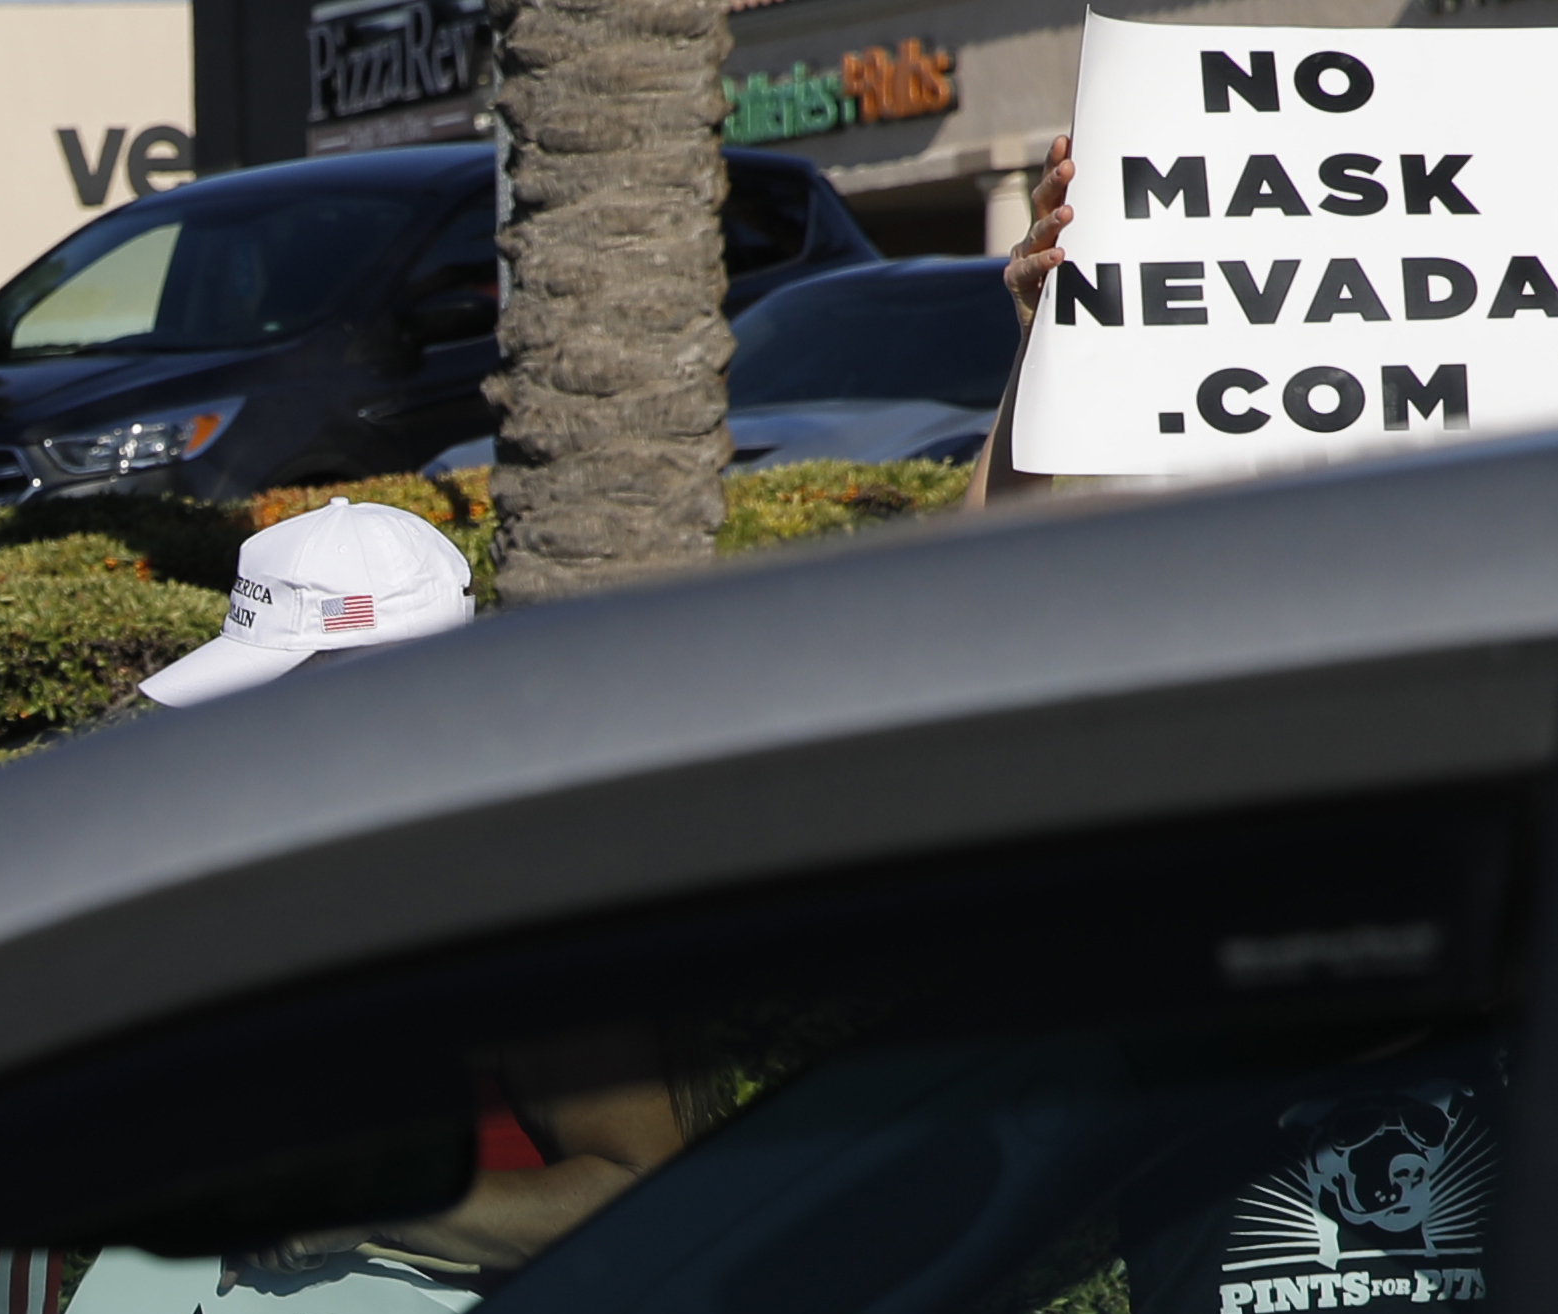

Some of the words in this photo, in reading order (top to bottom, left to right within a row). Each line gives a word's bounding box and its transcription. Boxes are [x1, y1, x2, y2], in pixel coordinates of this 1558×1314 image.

[1201, 51, 1374, 113] NO
[56, 125, 196, 206] ve
[1122, 153, 1481, 219] MASK
[1055, 256, 1558, 327] NEVADA
[1159, 364, 1471, 433] .COM
[228, 604, 257, 629] AIN
[1370, 1276, 1412, 1298] FOR
